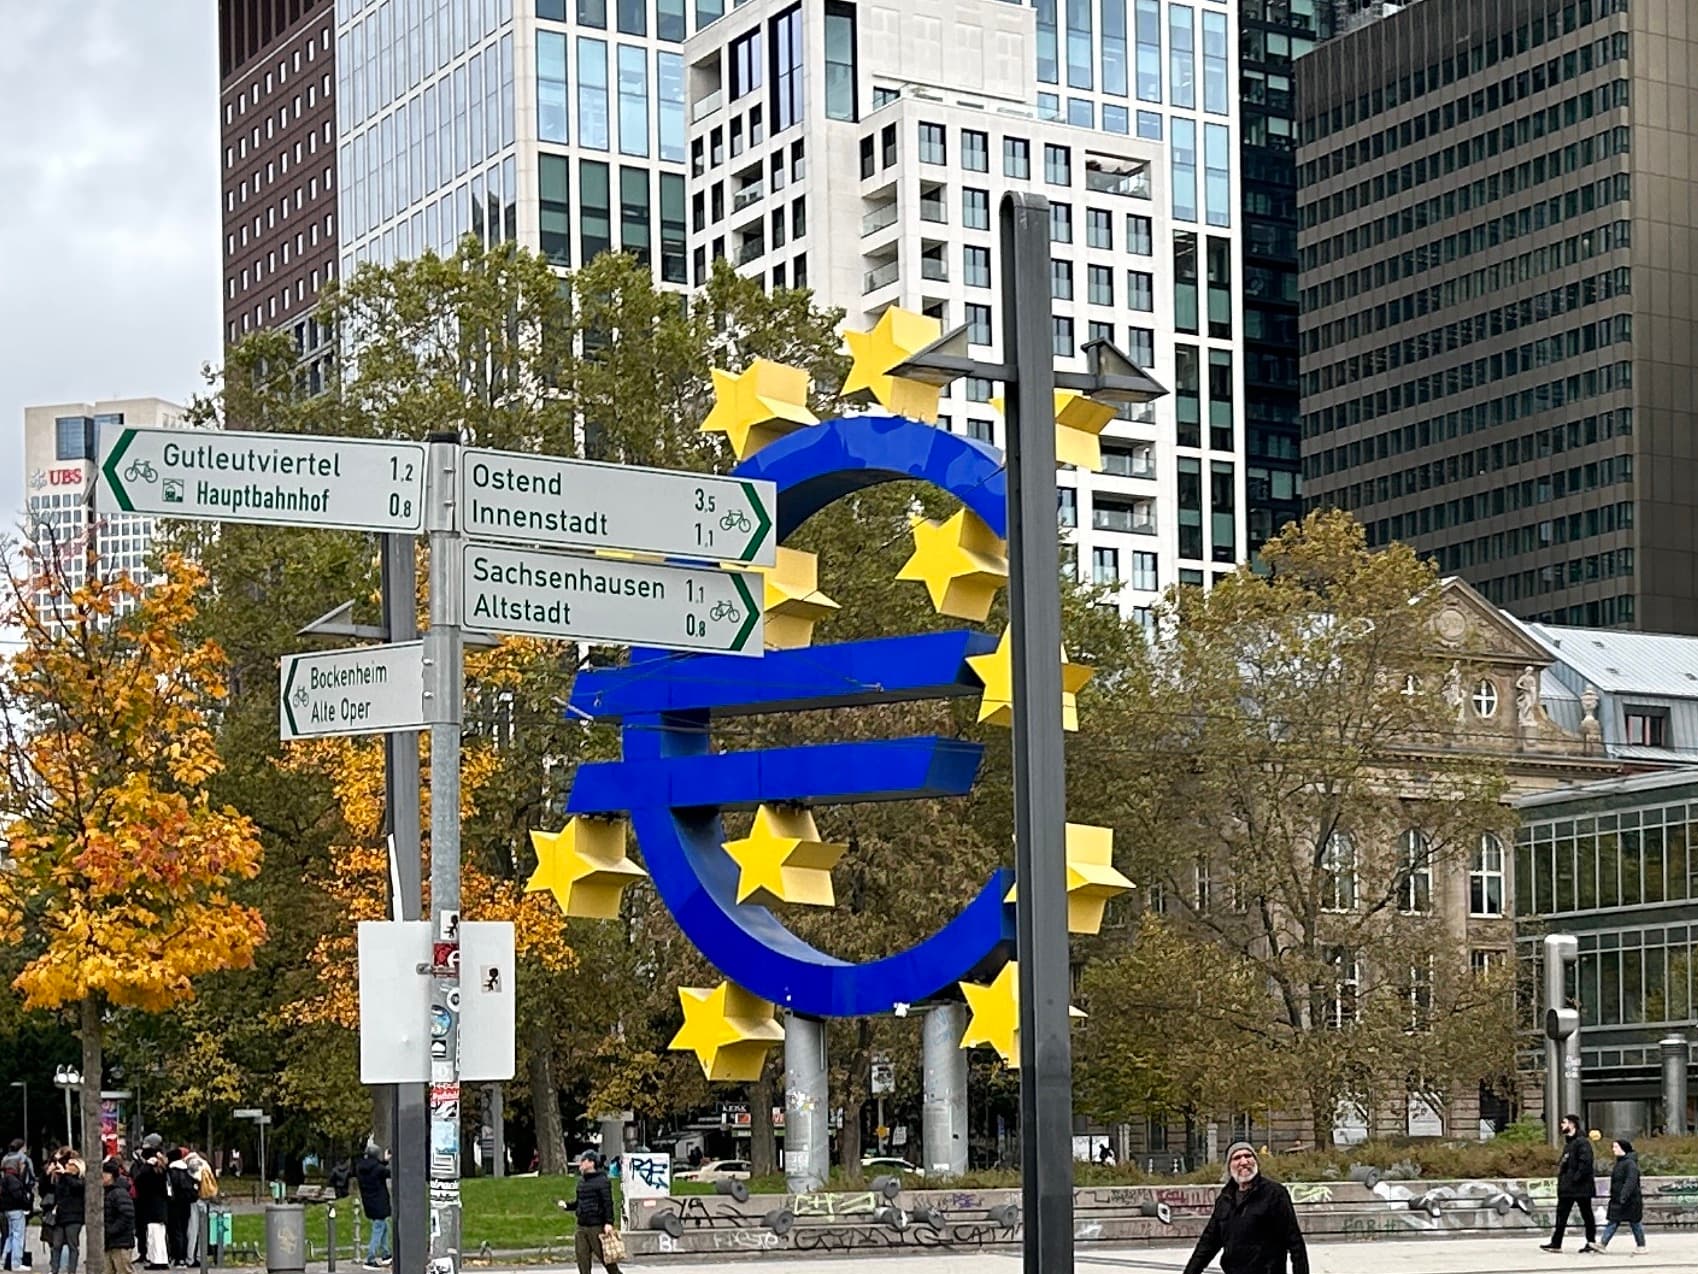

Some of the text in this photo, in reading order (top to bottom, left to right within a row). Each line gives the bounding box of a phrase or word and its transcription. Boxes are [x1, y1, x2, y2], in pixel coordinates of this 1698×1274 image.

[163, 443, 340, 476] Gutleutviertel
[49, 468, 82, 486] UBS
[473, 464, 561, 495] Ostend
[197, 481, 330, 513] Hauptbahnhof
[473, 500, 608, 535] Innenstadt
[474, 558, 665, 599] Sachsenhausen
[474, 594, 571, 625] Altstadt
[311, 660, 387, 690] Bockenheim
[311, 698, 371, 726] Alte Oper
